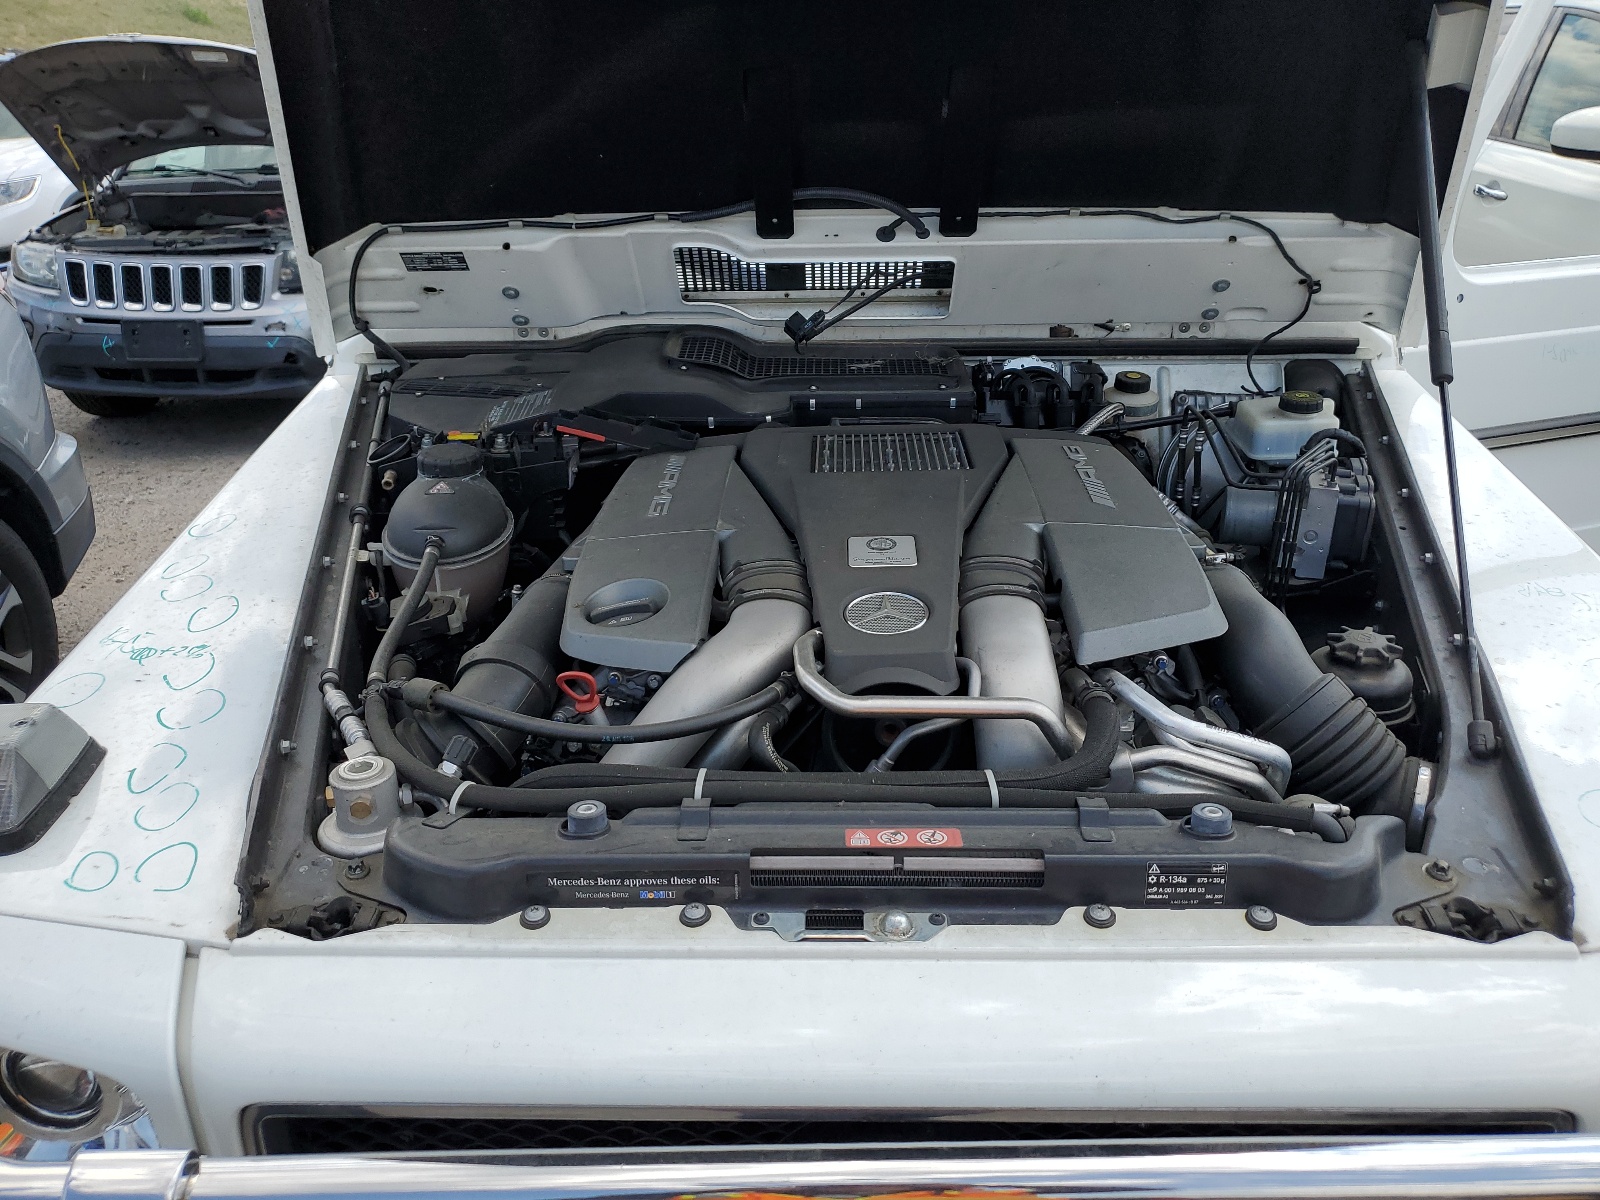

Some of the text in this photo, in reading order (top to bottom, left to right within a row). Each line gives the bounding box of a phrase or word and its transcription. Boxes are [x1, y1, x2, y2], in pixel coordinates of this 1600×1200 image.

[547, 876, 721, 887] Mercedes-Benz approves these oils:
[1160, 876, 1187, 884] R-134a
[575, 891, 630, 899] Mercedes-Benz
